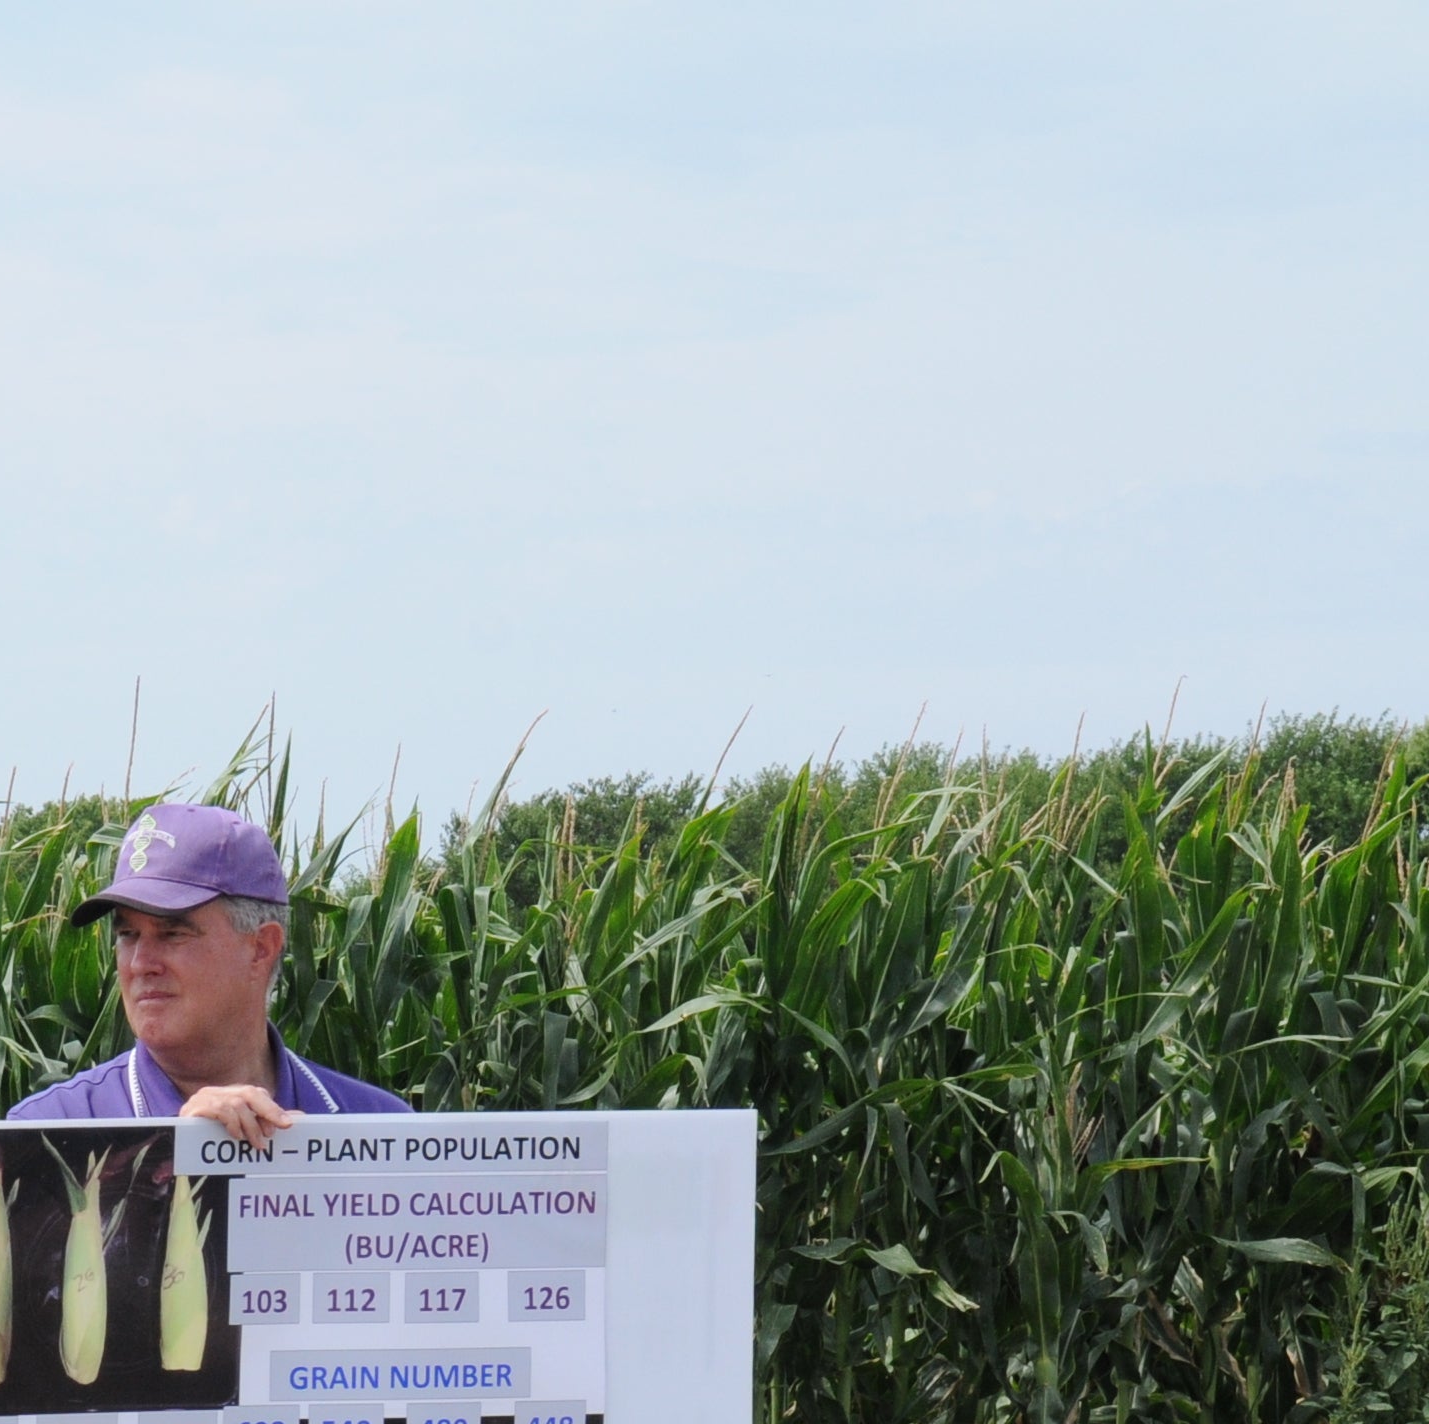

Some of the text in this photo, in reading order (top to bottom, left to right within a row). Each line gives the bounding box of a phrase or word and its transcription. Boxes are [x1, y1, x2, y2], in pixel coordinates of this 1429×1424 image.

[201, 1139, 274, 1163] CORN
[307, 1138, 396, 1162] PLANT
[405, 1136, 581, 1160] POPULATION
[240, 1191, 596, 1217] FINAL YIELD CALCULATION
[345, 1232, 489, 1264] (BU/ACRE)
[242, 1287, 570, 1313] 103 112 117 126
[289, 1364, 512, 1390] GRAIN NUMBER
